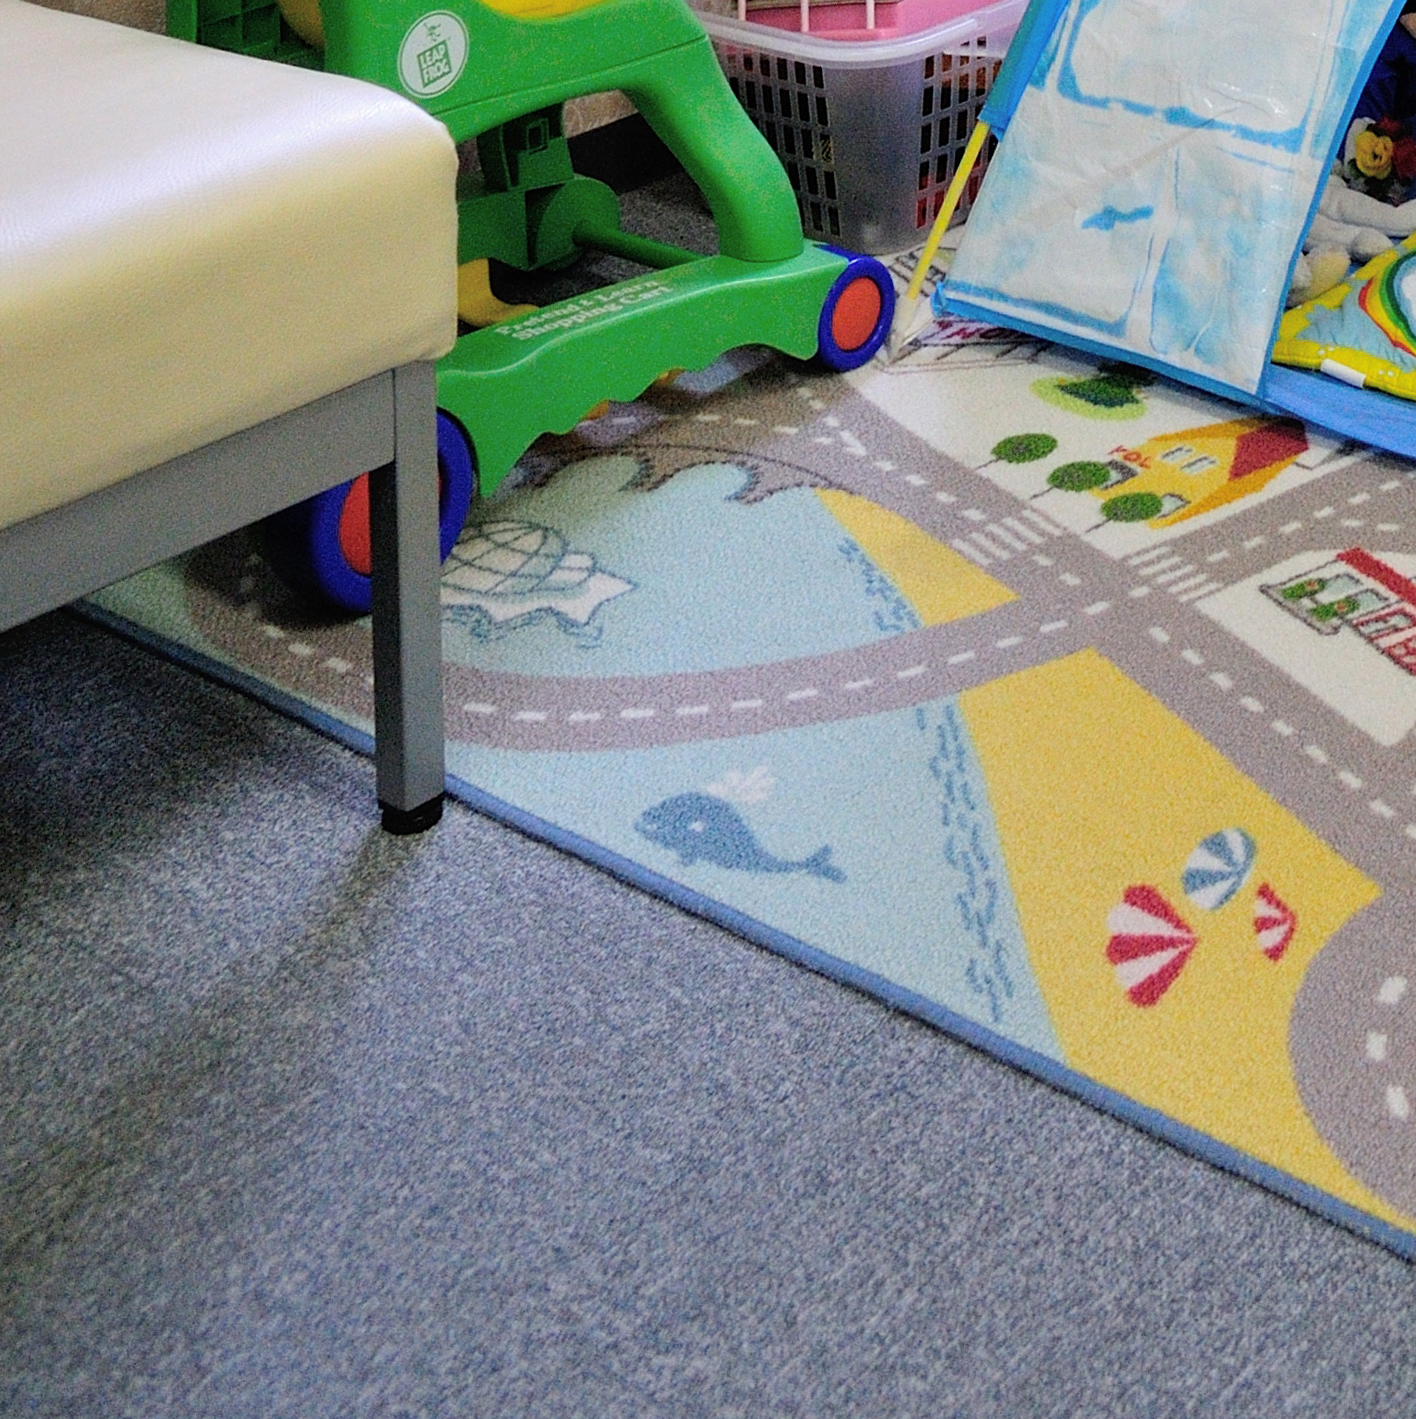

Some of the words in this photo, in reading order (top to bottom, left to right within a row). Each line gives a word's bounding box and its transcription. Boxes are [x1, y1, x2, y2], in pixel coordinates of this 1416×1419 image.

[420, 44, 446, 68] LEAP
[422, 58, 450, 85] FROG
[494, 304, 580, 335] Pretend
[594, 281, 659, 301] Learn
[512, 304, 623, 340] Shopping
[619, 287, 673, 304] Cart
